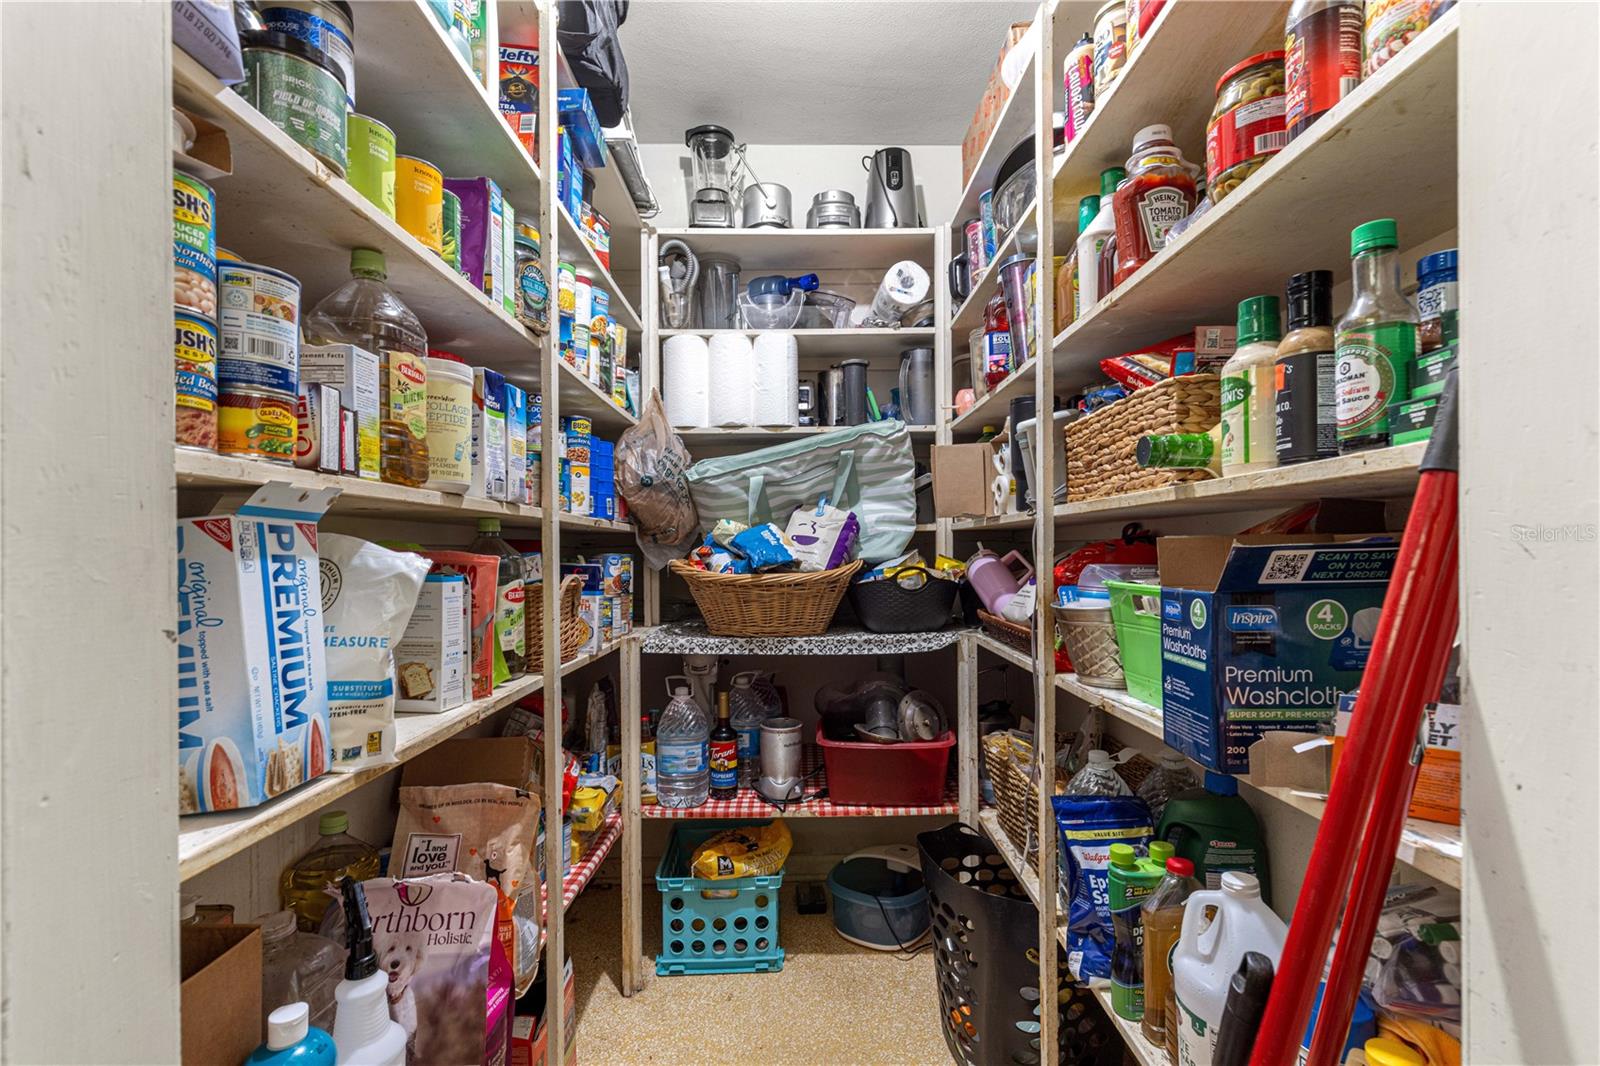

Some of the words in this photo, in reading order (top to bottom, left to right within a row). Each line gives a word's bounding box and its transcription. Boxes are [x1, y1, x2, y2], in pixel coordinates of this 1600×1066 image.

[499, 48, 540, 65] Hefty
[174, 188, 210, 223] SH'S
[1153, 194, 1177, 204] HEINZ
[1150, 206, 1182, 216] TOMATO
[1151, 214, 1181, 223] KETCHUP
[299, 352, 325, 361] plement
[326, 352, 345, 360] Facts
[528, 394, 543, 403] GO
[1221, 387, 1245, 405] INI'S
[1342, 394, 1371, 405] Sauce
[427, 401, 471, 417] OLLAGE
[427, 412, 467, 427] EPTIDE
[427, 463, 459, 471] PPLEMENT
[1317, 553, 1351, 561] SCAN
[1353, 552, 1368, 560] TO
[319, 561, 339, 584] RTHUR
[1328, 562, 1346, 570] ON
[1350, 561, 1381, 569] YOUR
[1345, 570, 1388, 578] ORDER!
[178, 561, 224, 628] original
[294, 558, 316, 617] original
[1194, 602, 1201, 617] 4
[1317, 604, 1334, 623] 4
[1232, 611, 1273, 627] Inspire
[268, 524, 309, 730] PREMIUM
[1163, 624, 1191, 640] Premium
[1313, 623, 1342, 631] PACKS
[199, 630, 209, 661] topped
[1163, 637, 1207, 660] Washcloths
[200, 661, 211, 679] with
[270, 656, 279, 685] SALTINE
[1225, 666, 1313, 683] Premium
[203, 680, 212, 696] sea
[332, 684, 384, 692] SUBSTITUTE
[1226, 687, 1345, 705] Washcloth
[204, 697, 214, 712] salt
[328, 708, 367, 719] UTEN-FREE
[1229, 711, 1257, 719] SUPER
[1259, 711, 1284, 720] SOFT,
[1286, 710, 1336, 719] PRE-MOIST
[710, 745, 735, 763] Torani
[1227, 746, 1246, 754] 200
[1112, 830, 1125, 838] SIZE
[413, 847, 447, 864] love
[431, 844, 447, 852] and
[1082, 851, 1111, 864] Walgre
[410, 864, 425, 872] and
[1092, 889, 1110, 905] Sa
[1125, 888, 1133, 897] 2
[370, 907, 476, 934] rthborn
